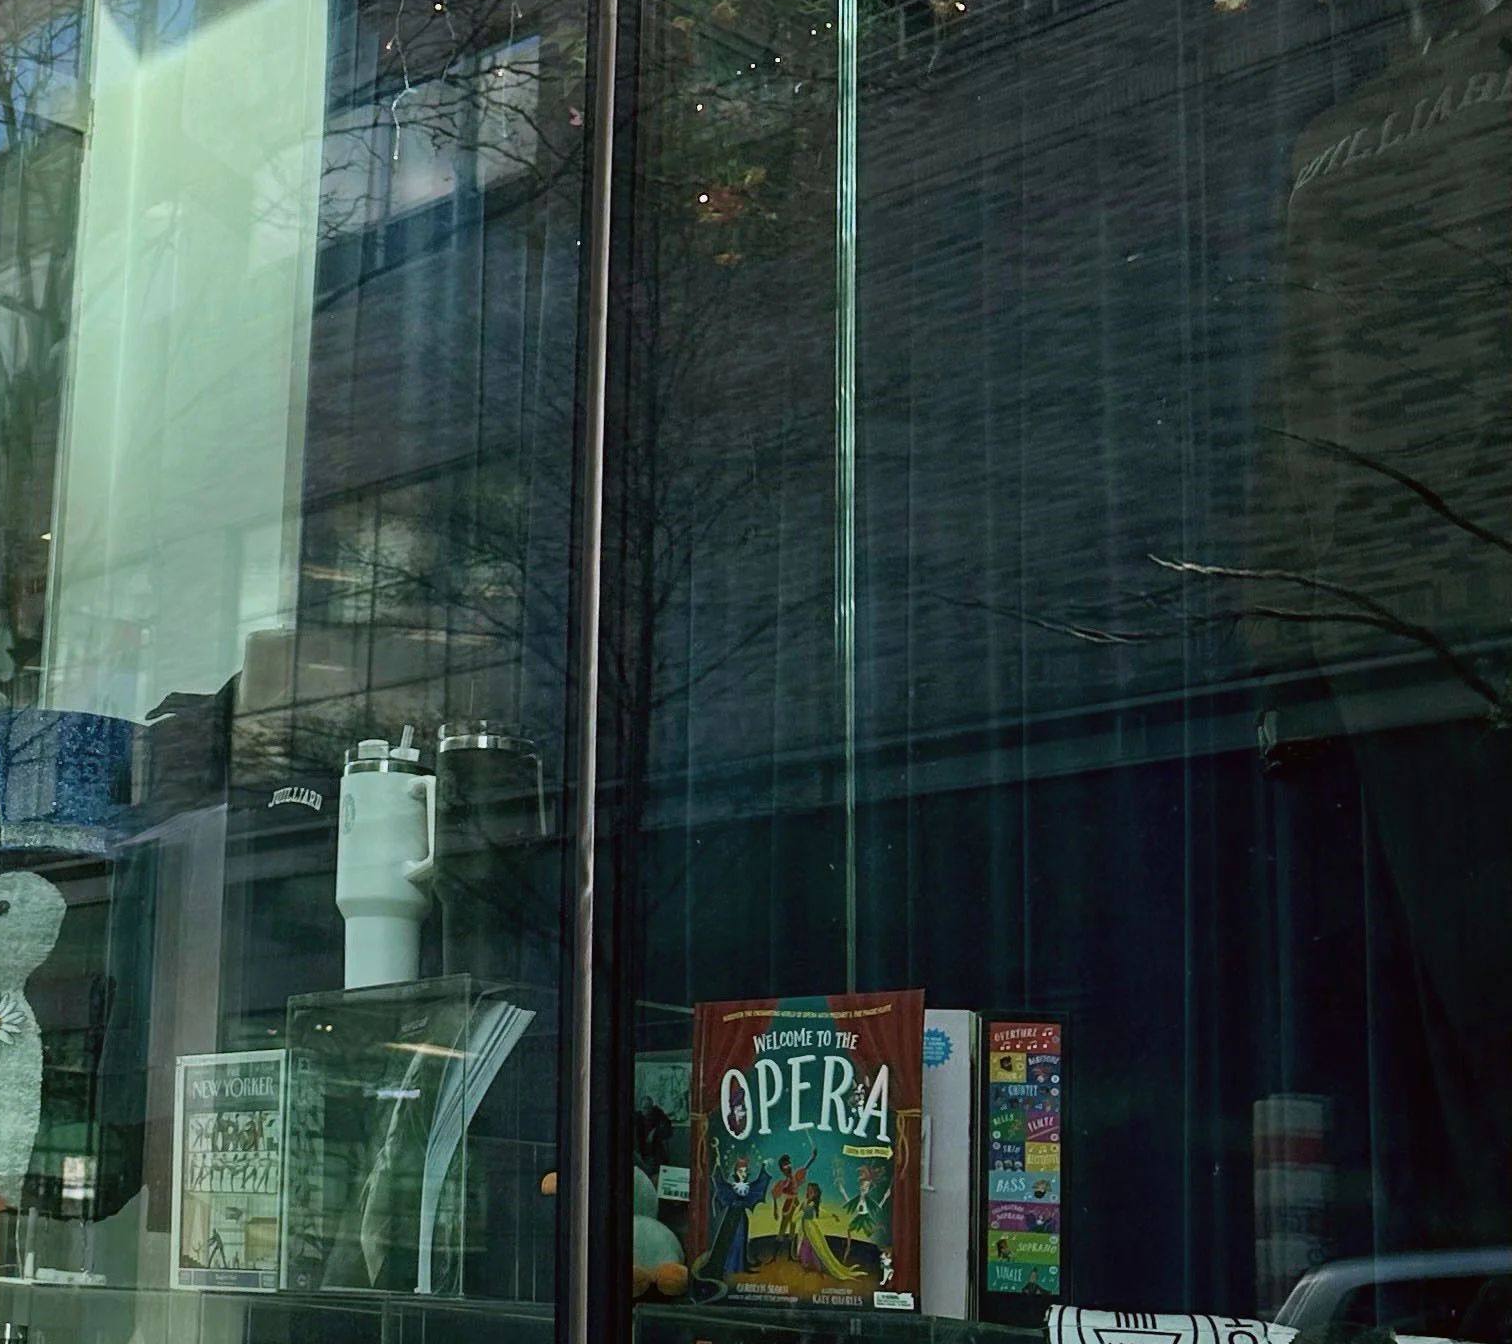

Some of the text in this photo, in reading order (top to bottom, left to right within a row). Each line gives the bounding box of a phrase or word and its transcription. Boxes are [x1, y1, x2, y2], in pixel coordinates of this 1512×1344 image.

[268, 786, 323, 811] JUILLIARD
[753, 1028, 860, 1054] WELCOME TO THE
[994, 1027, 1037, 1042] OVERTURE
[191, 1075, 275, 1100] NEW YORKER
[721, 1054, 891, 1142] OPERA
[995, 1177, 1026, 1193] BASS
[1016, 1242, 1057, 1254] SOPRANO
